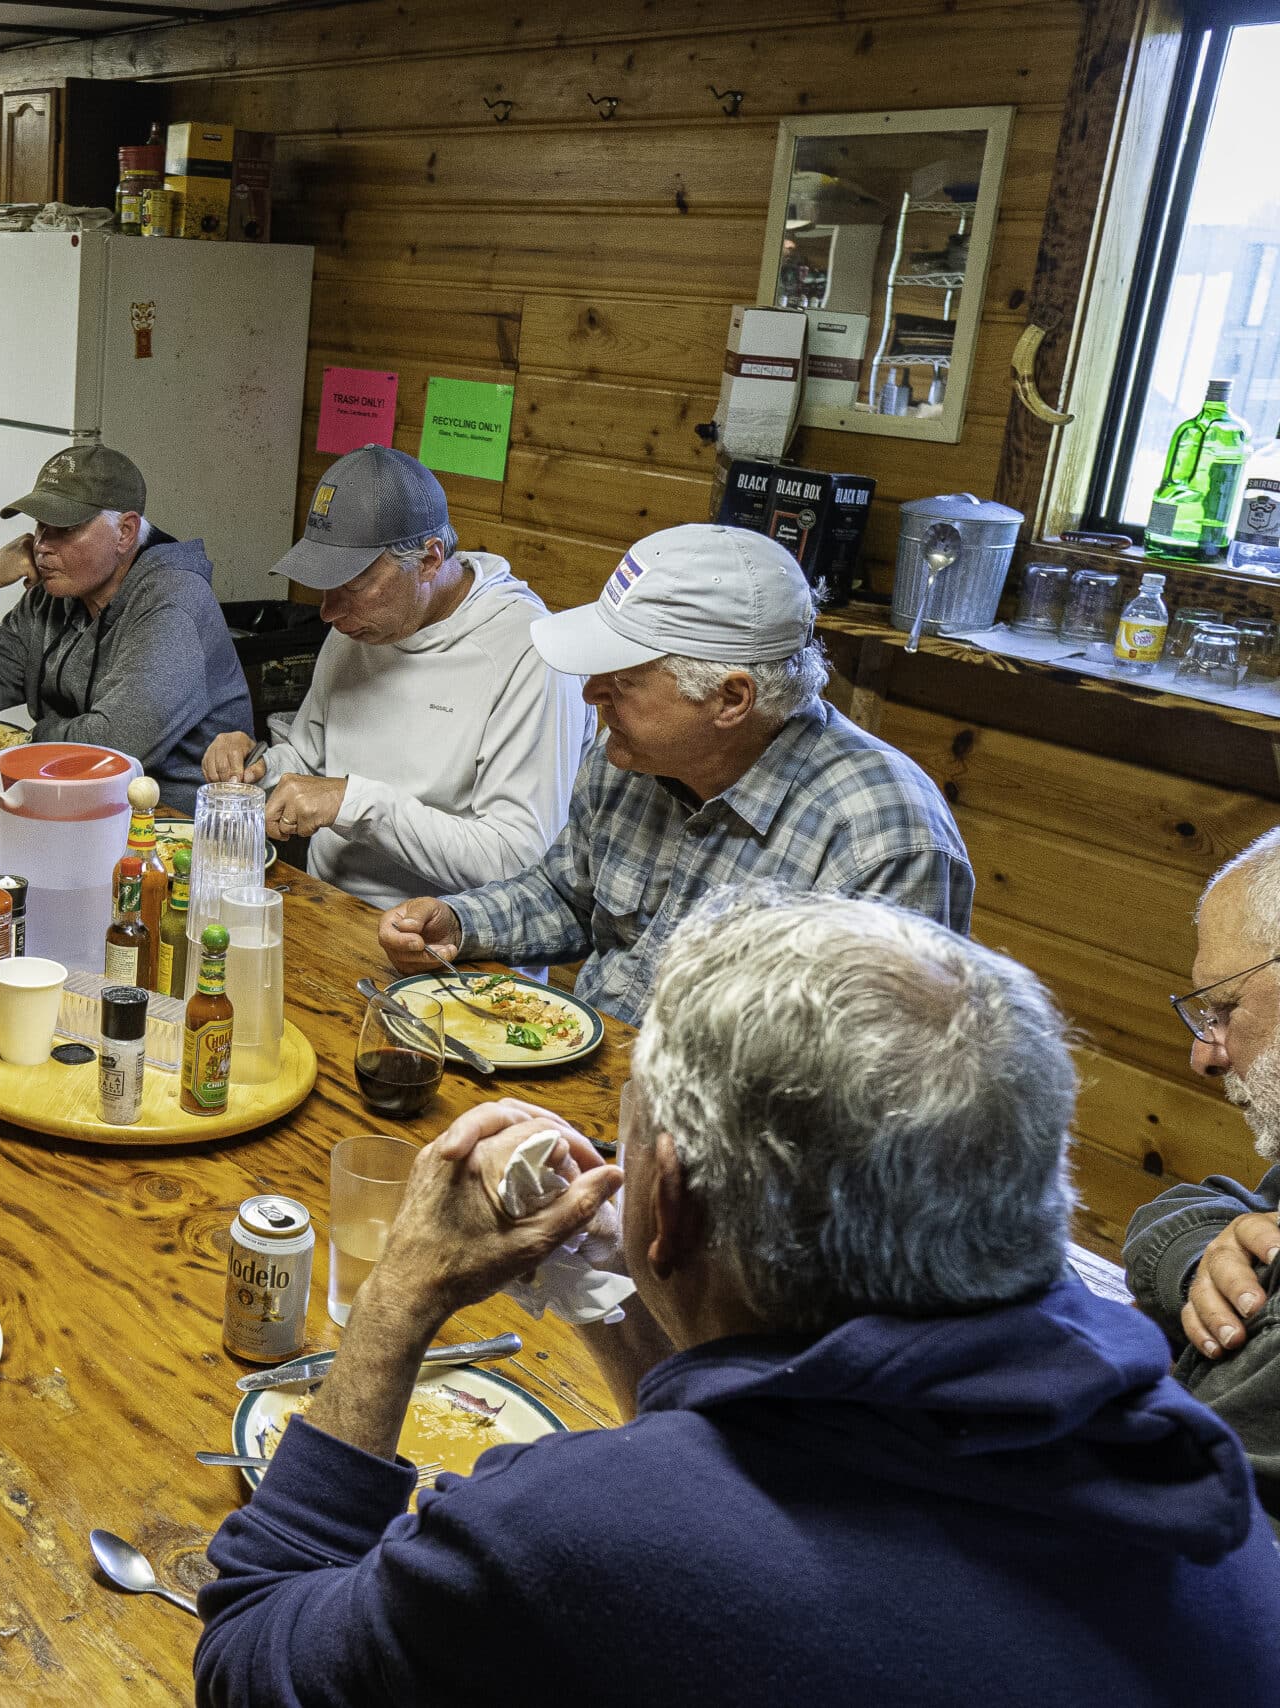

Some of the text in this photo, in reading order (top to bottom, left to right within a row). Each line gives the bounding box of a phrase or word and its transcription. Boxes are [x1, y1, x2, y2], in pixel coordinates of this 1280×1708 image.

[333, 393, 385, 408] TRASH ONLY!
[432, 415, 502, 433] RECYCLING ONLY!
[737, 473, 769, 493] BLACK
[775, 478, 822, 501] BLACK BOX
[1248, 480, 1280, 491] SMIRNO
[834, 488, 870, 506] BLACK BOX
